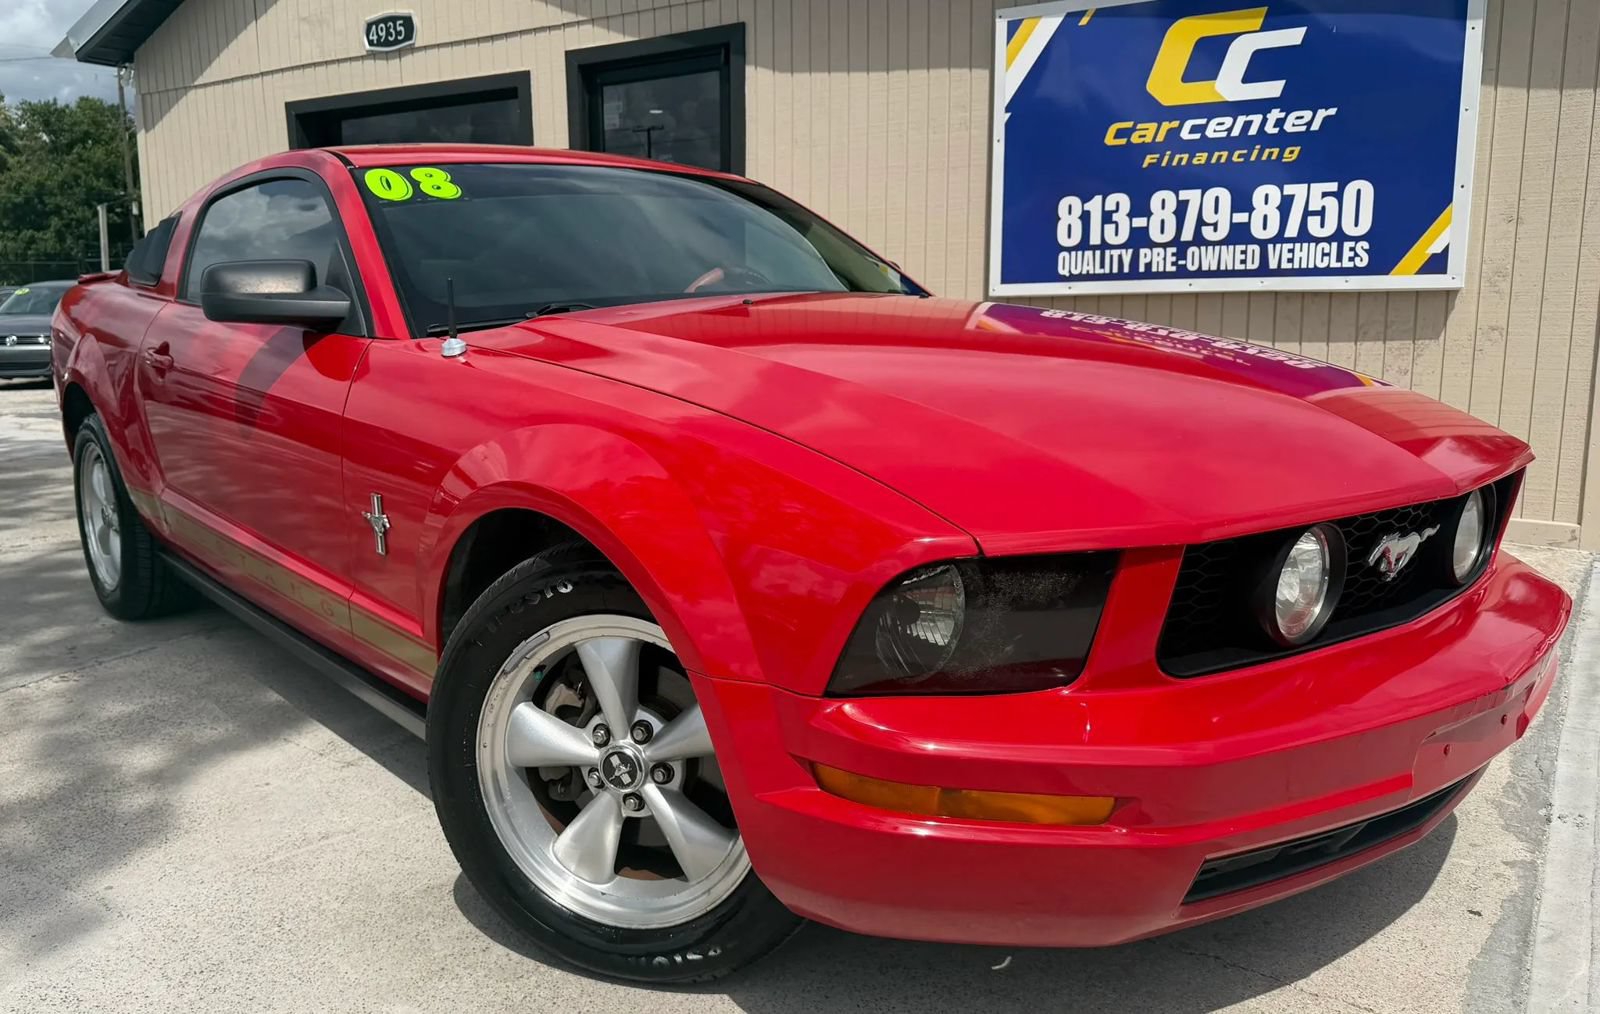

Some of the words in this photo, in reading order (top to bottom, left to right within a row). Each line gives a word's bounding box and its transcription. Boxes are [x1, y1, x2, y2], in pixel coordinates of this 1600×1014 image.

[369, 20, 405, 44] 4935
[1142, 145, 1302, 168] Financing
[364, 167, 463, 201] 08
[1056, 179, 1375, 248] 813-879-8750
[1057, 248, 1133, 277] QUALITY
[1138, 244, 1260, 273] PRE-OWNED
[1267, 240, 1370, 270] VEHICLES
